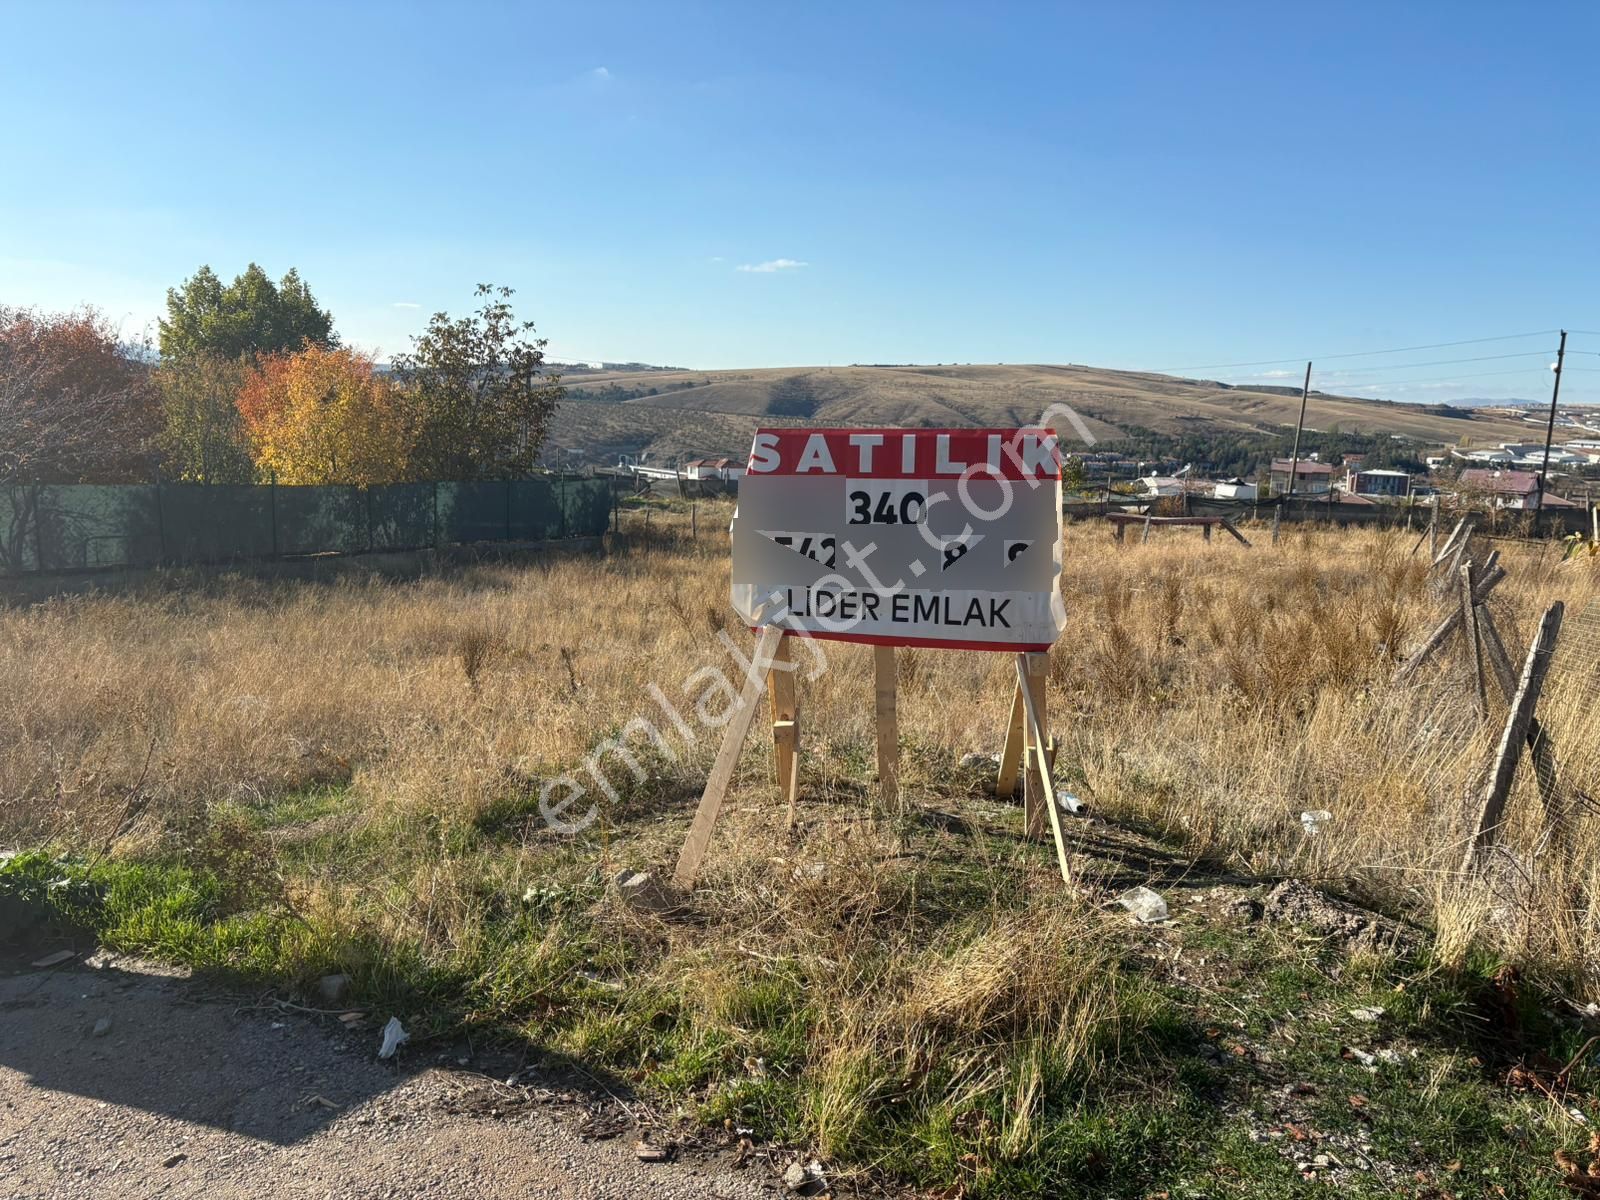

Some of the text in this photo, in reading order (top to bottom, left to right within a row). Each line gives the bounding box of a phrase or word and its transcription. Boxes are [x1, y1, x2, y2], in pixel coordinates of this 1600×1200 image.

[750, 433, 1060, 476] SATILIK
[849, 491, 927, 524] 340
[787, 586, 1011, 628] LİDER EMLAK
